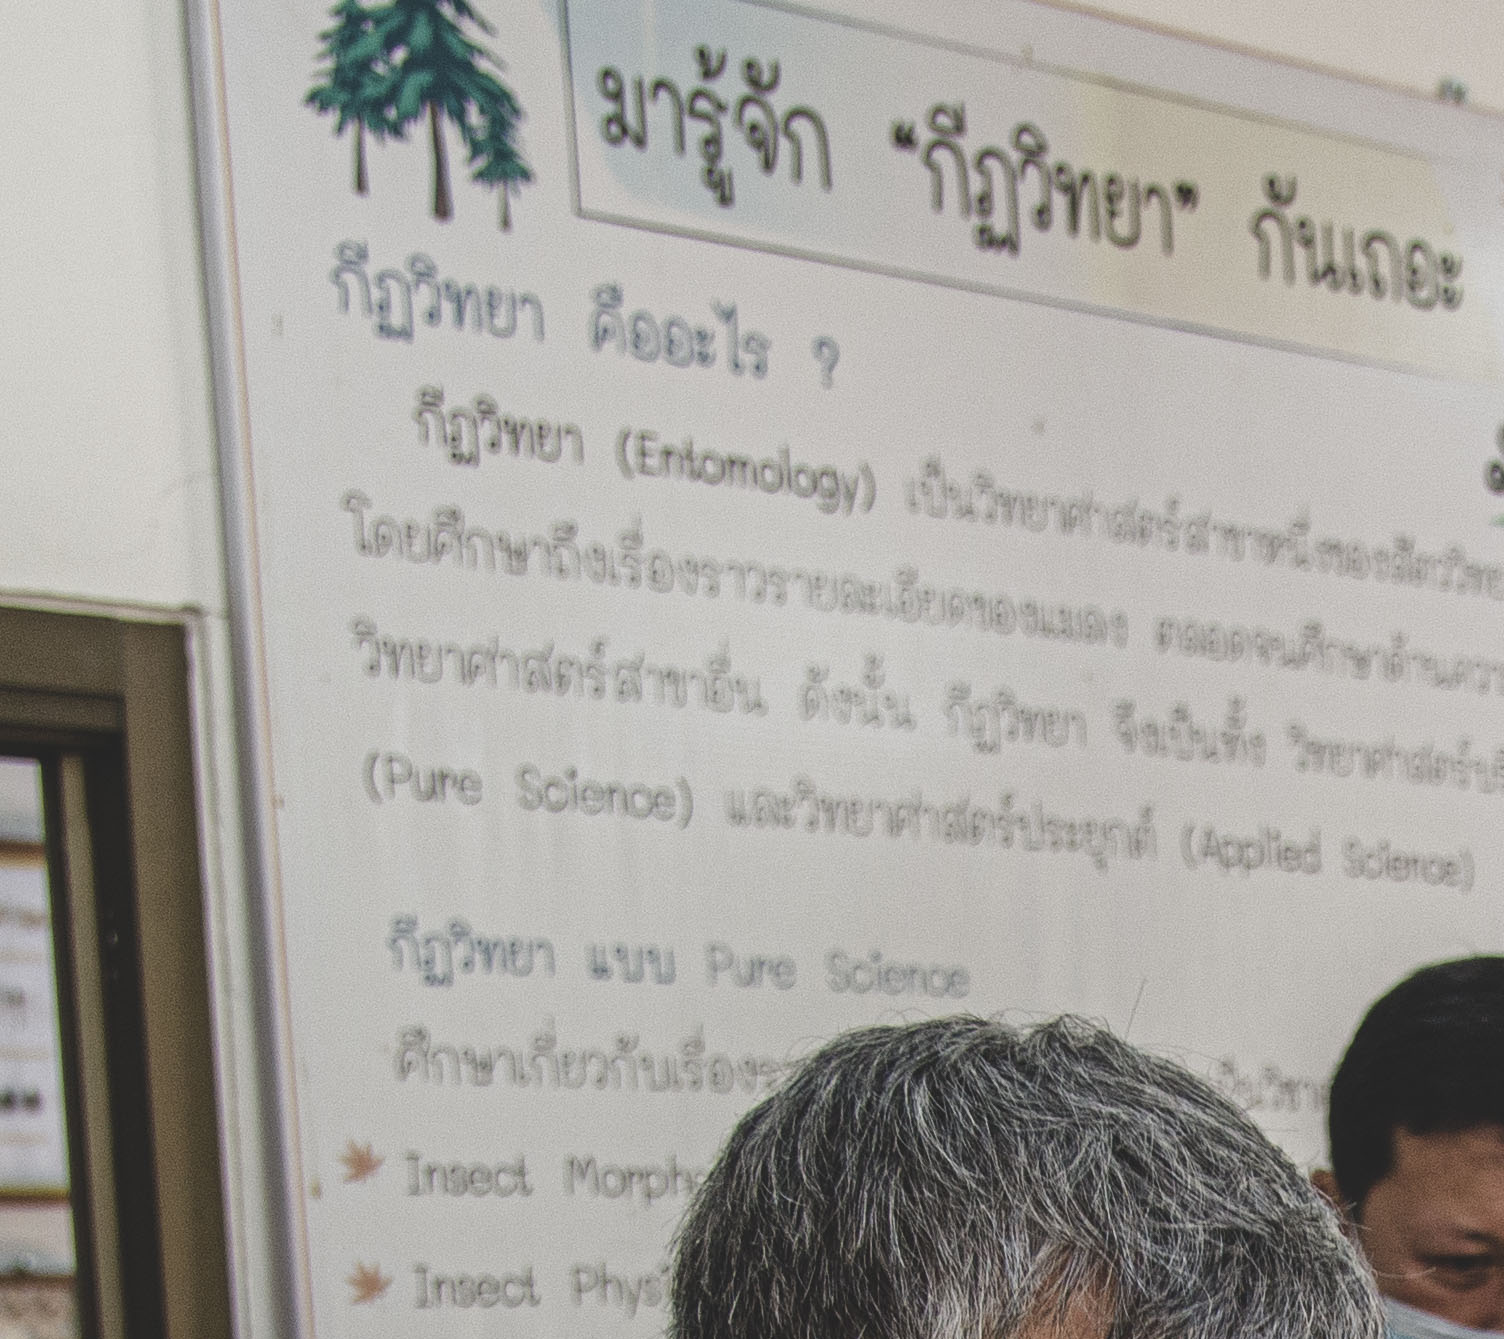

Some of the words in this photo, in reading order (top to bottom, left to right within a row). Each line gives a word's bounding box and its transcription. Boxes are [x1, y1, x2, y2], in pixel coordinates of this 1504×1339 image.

[598, 43, 834, 208] มารู้จัก
[1249, 175, 1465, 312] กันเถอะ
[329, 238, 546, 343] กีฏวิทยา
[587, 281, 772, 381] คืออะไร
[812, 336, 842, 390] ?
[412, 384, 585, 468] กีฏวิทยา
[615, 425, 880, 518] (Entomology)
[351, 614, 769, 718] วิทยาศาสตร์สาขาอื่น
[798, 649, 916, 732] ดังนั้น
[946, 681, 1088, 755] กีฏวิทยา
[361, 749, 484, 804] (Pure
[515, 762, 695, 831] Science)
[1181, 824, 1322, 880] (Applied
[1343, 845, 1477, 894] Science)
[387, 914, 556, 988] กีฏวิทยา
[586, 940, 677, 988] แบบ
[705, 942, 797, 991] Pure
[828, 949, 973, 999] Science
[405, 1150, 534, 1197] Insect
[413, 1262, 542, 1309] Insect
